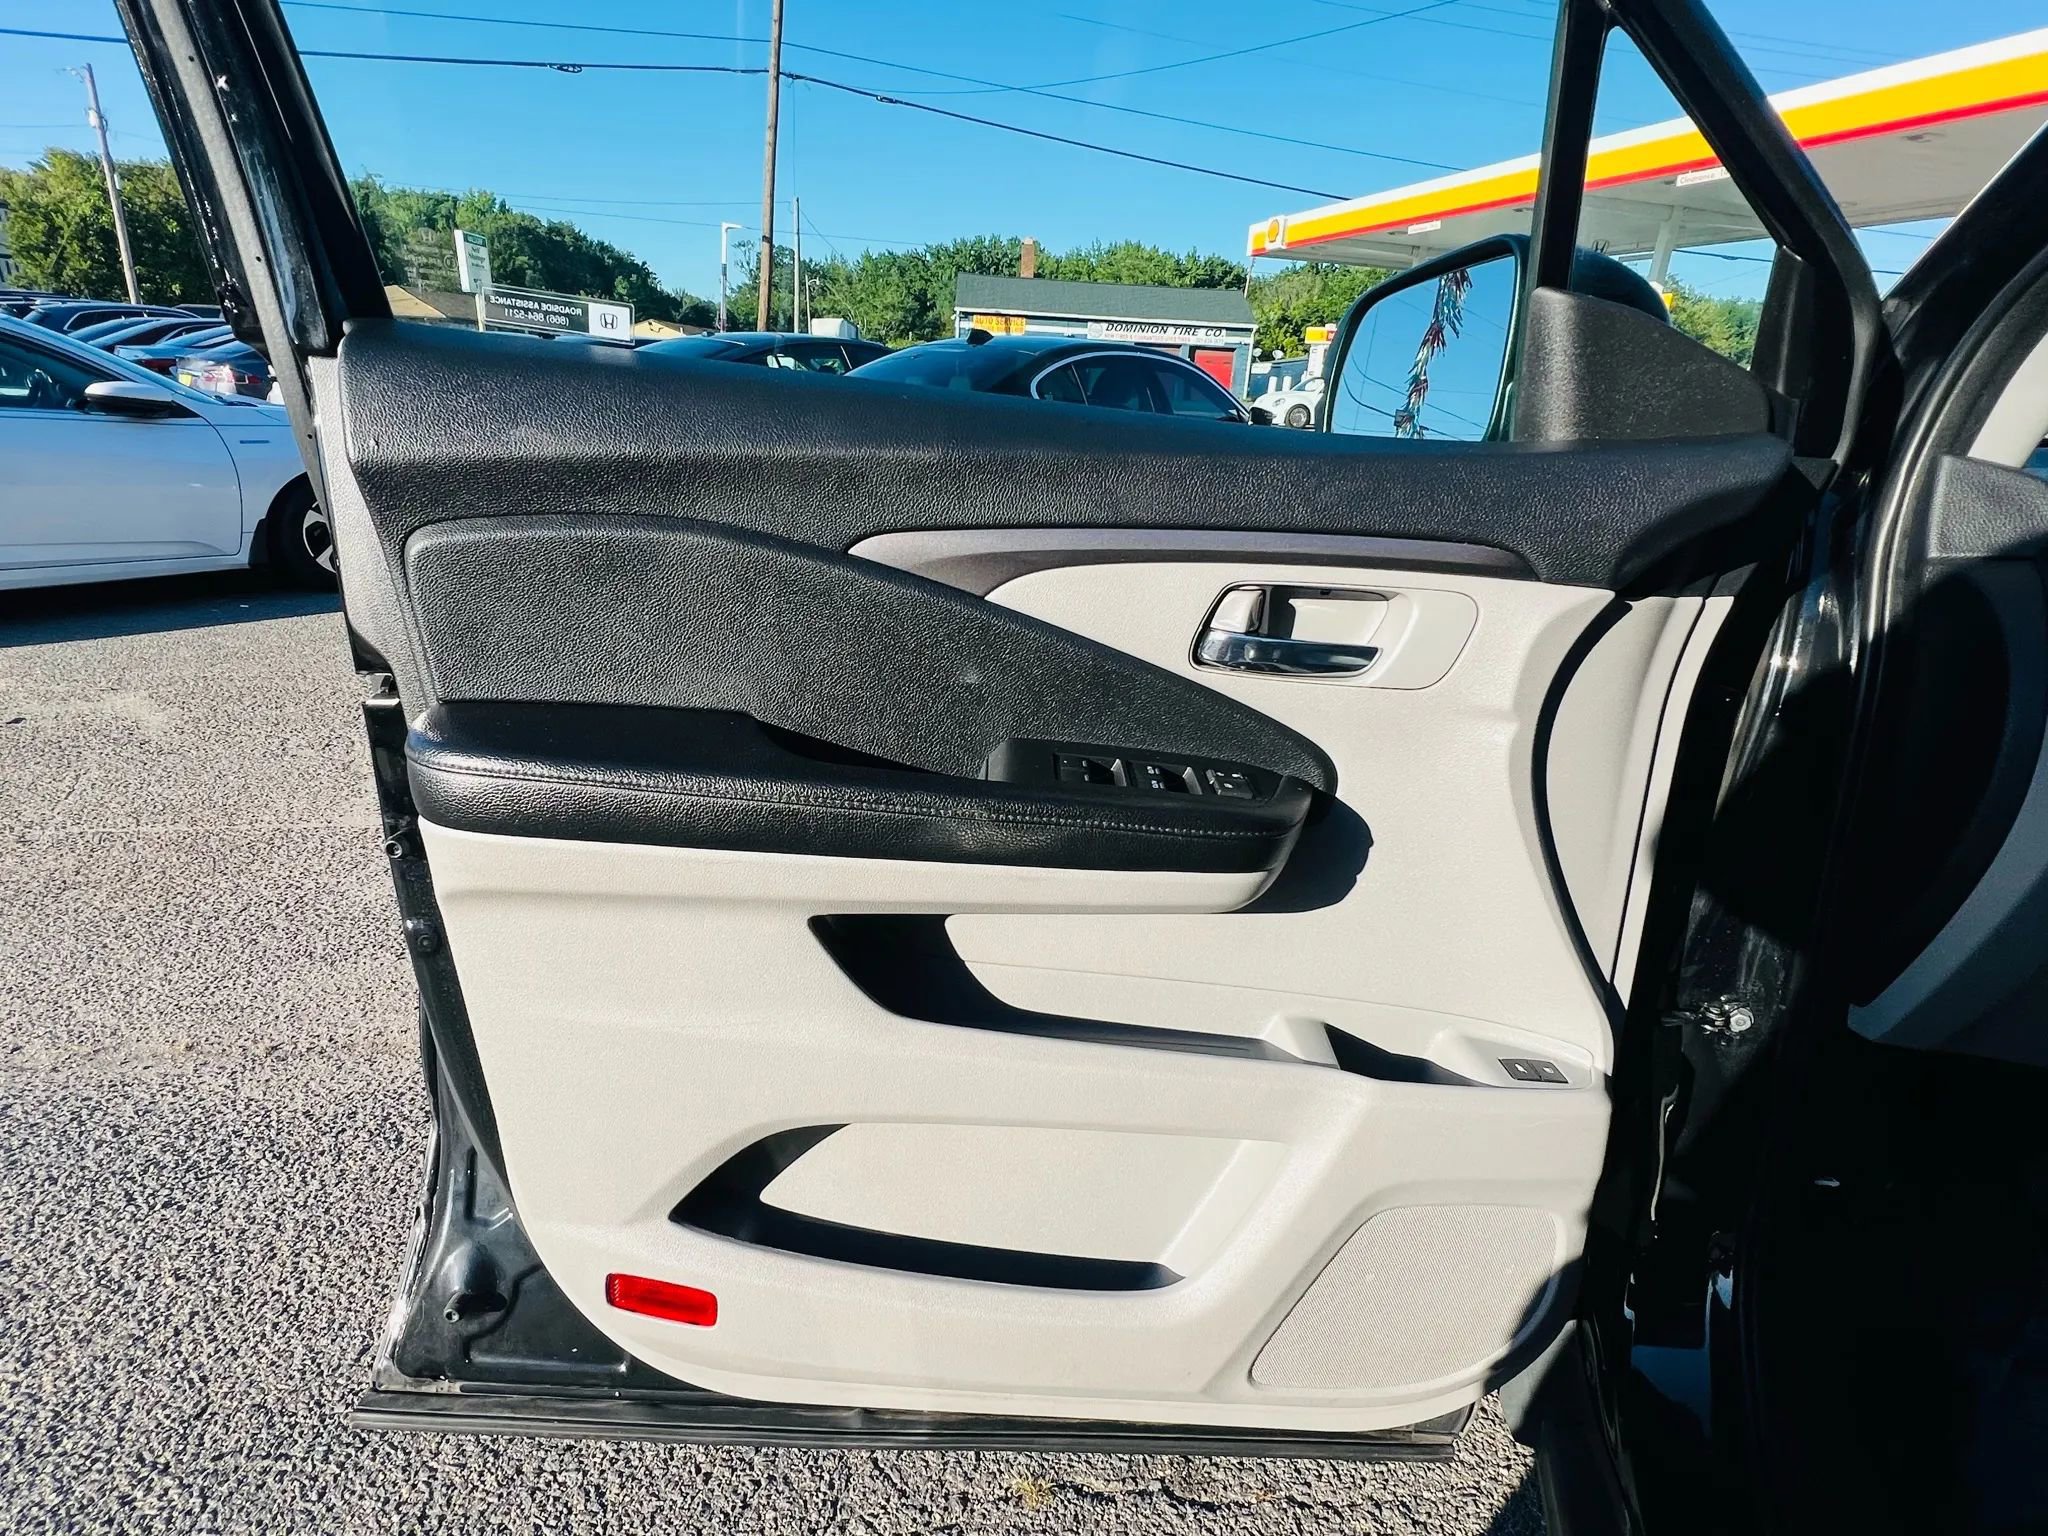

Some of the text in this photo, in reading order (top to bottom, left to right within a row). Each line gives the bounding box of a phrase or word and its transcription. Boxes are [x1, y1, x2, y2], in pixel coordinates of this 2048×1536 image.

[995, 318, 1025, 327] SERVICE
[1105, 323, 1224, 338] DOMINION TIRE CO.
